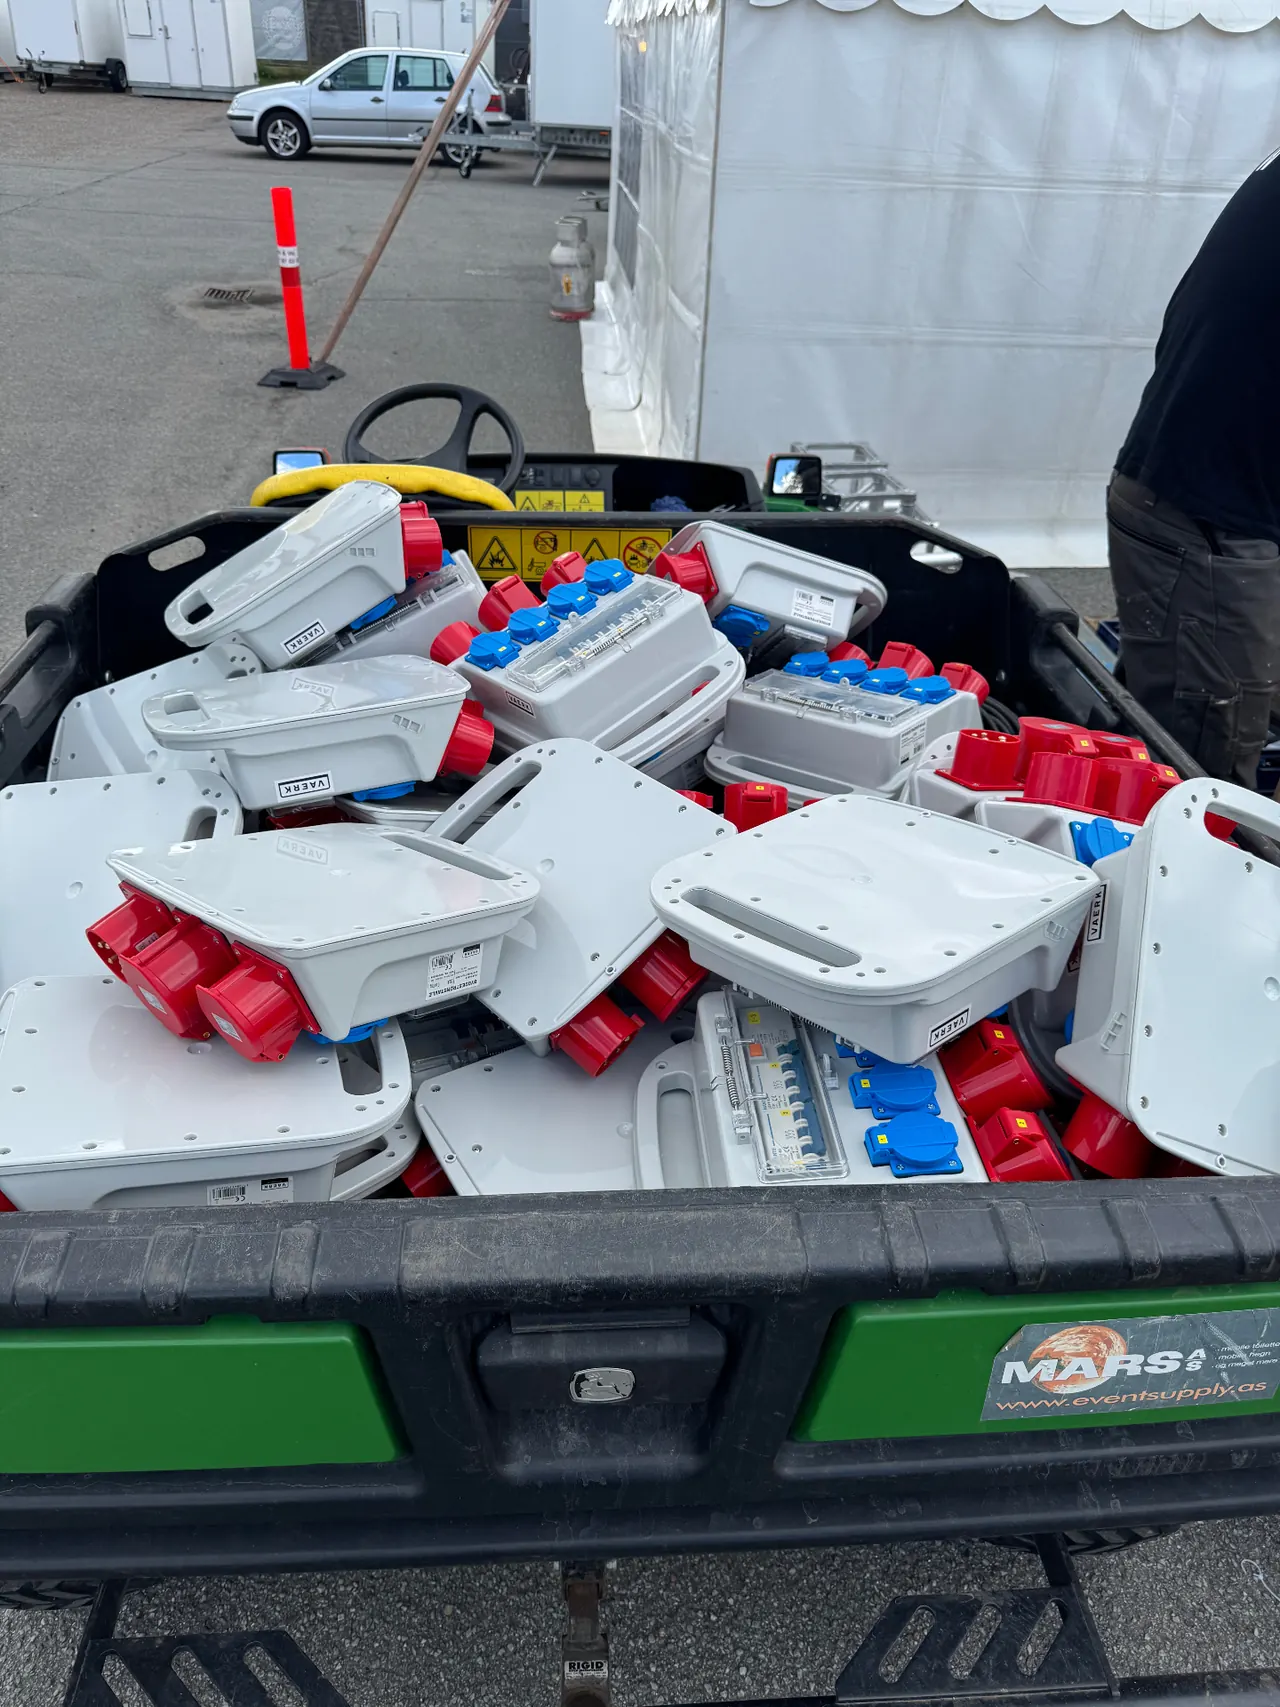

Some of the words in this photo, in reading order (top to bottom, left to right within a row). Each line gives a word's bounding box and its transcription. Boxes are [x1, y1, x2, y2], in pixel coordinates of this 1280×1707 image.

[290, 628, 320, 650] VAERK
[284, 779, 326, 794] VAERK
[1090, 890, 1103, 936] VAERK
[933, 1016, 964, 1041] VAERK
[1001, 1350, 1184, 1384] MARS
[996, 1380, 1267, 1411] www.eventsupply.as
[569, 1661, 604, 1670] RIGID
